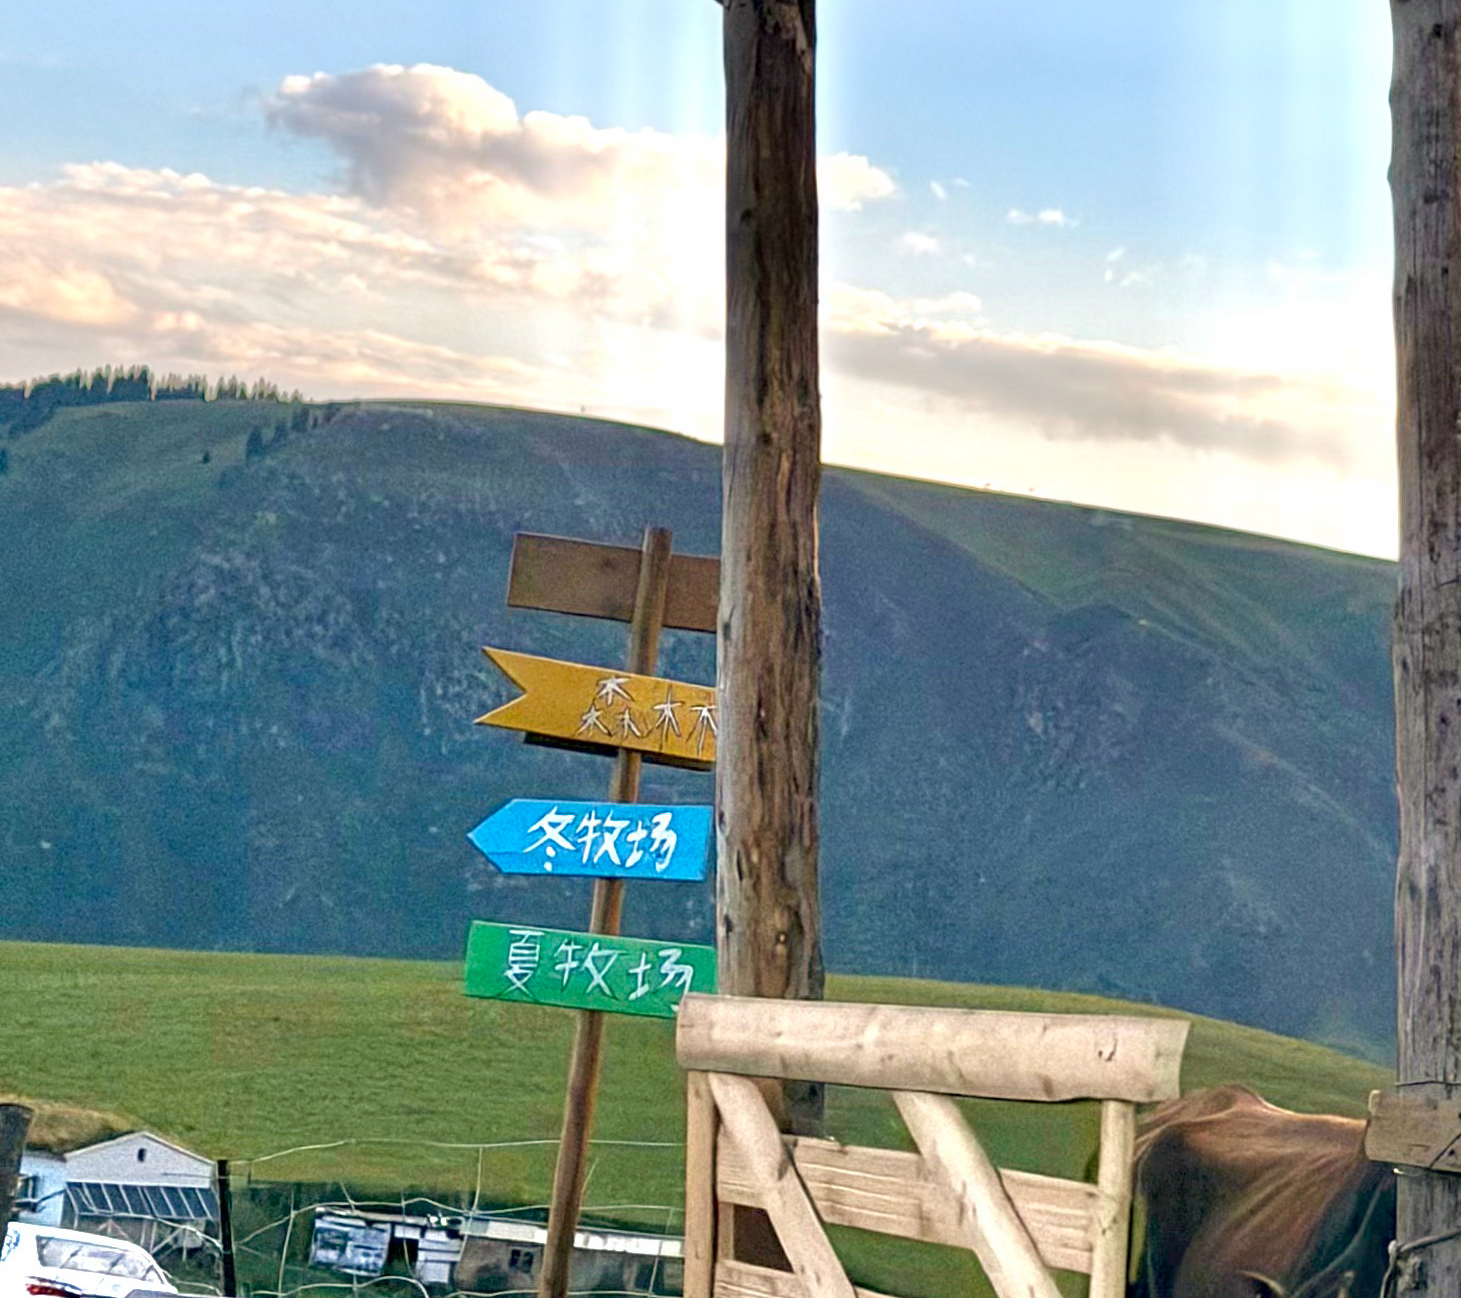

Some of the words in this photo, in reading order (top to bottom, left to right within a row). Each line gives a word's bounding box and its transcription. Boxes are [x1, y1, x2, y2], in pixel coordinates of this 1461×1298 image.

[523, 805, 677, 873] 冬牧场
[501, 928, 694, 1012] 夏牧场
